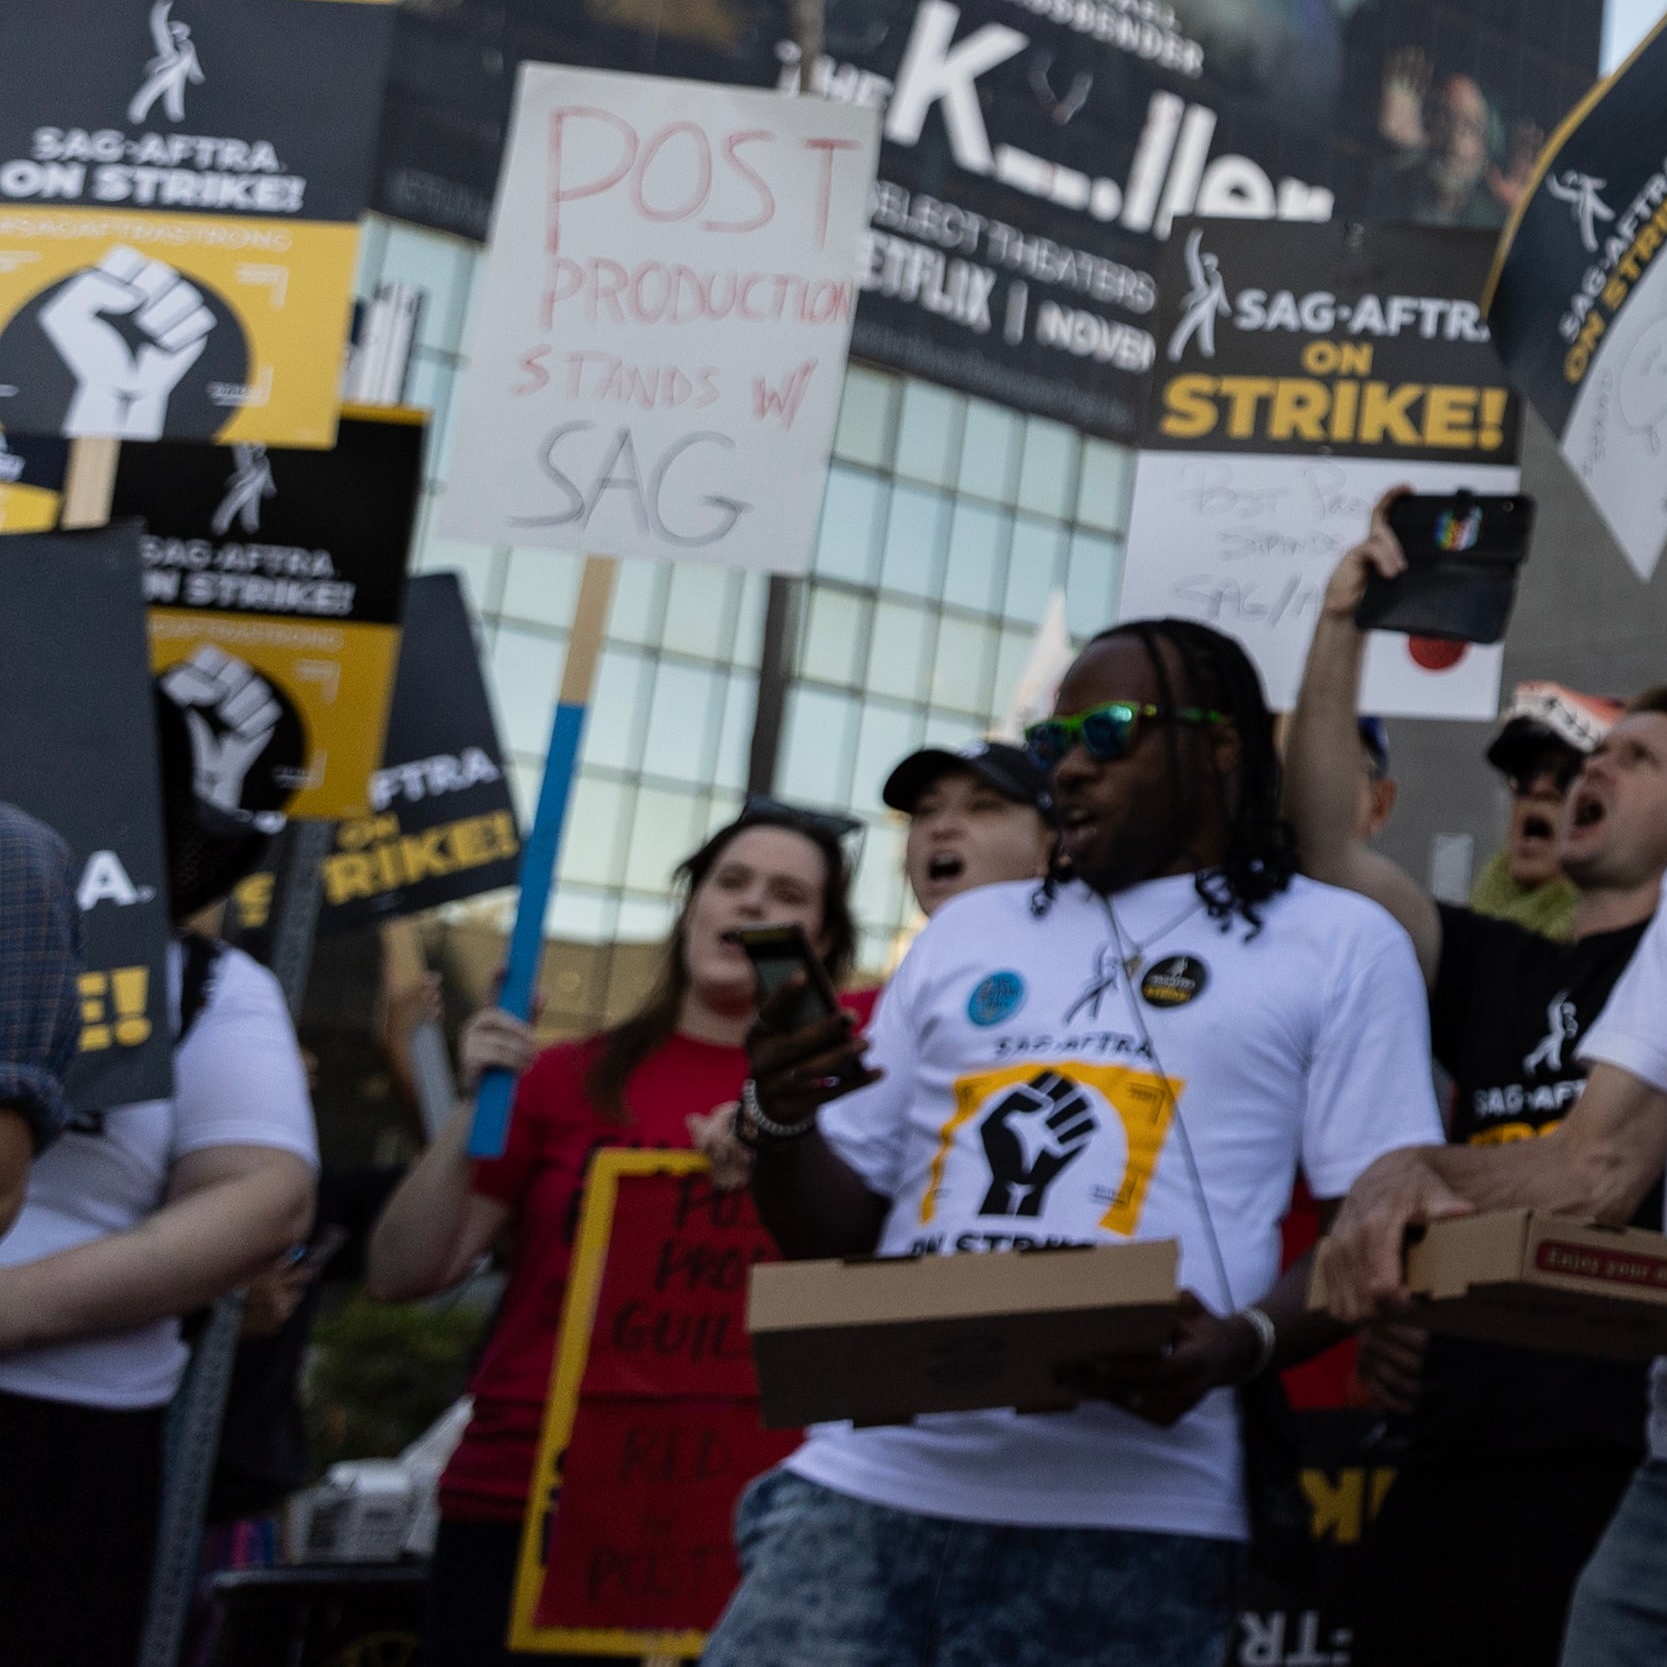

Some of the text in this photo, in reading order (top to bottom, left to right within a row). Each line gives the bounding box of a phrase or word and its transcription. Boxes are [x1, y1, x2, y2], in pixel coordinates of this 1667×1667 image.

[0, 158, 308, 215] ON STRIKE!
[546, 105, 862, 254] POST
[540, 253, 858, 331] PRODUCTION
[856, 226, 999, 337] ETFLIX
[511, 342, 722, 411] STANDS
[1303, 339, 1373, 376] ON
[1563, 309, 1608, 385] ON
[1160, 374, 1508, 451] STRIKE!
[507, 418, 753, 549] SAG
[184, 571, 357, 617] STRIKE!
[1547, 1247, 1601, 1276] Enjoy
[1604, 1260, 1652, 1280] your
